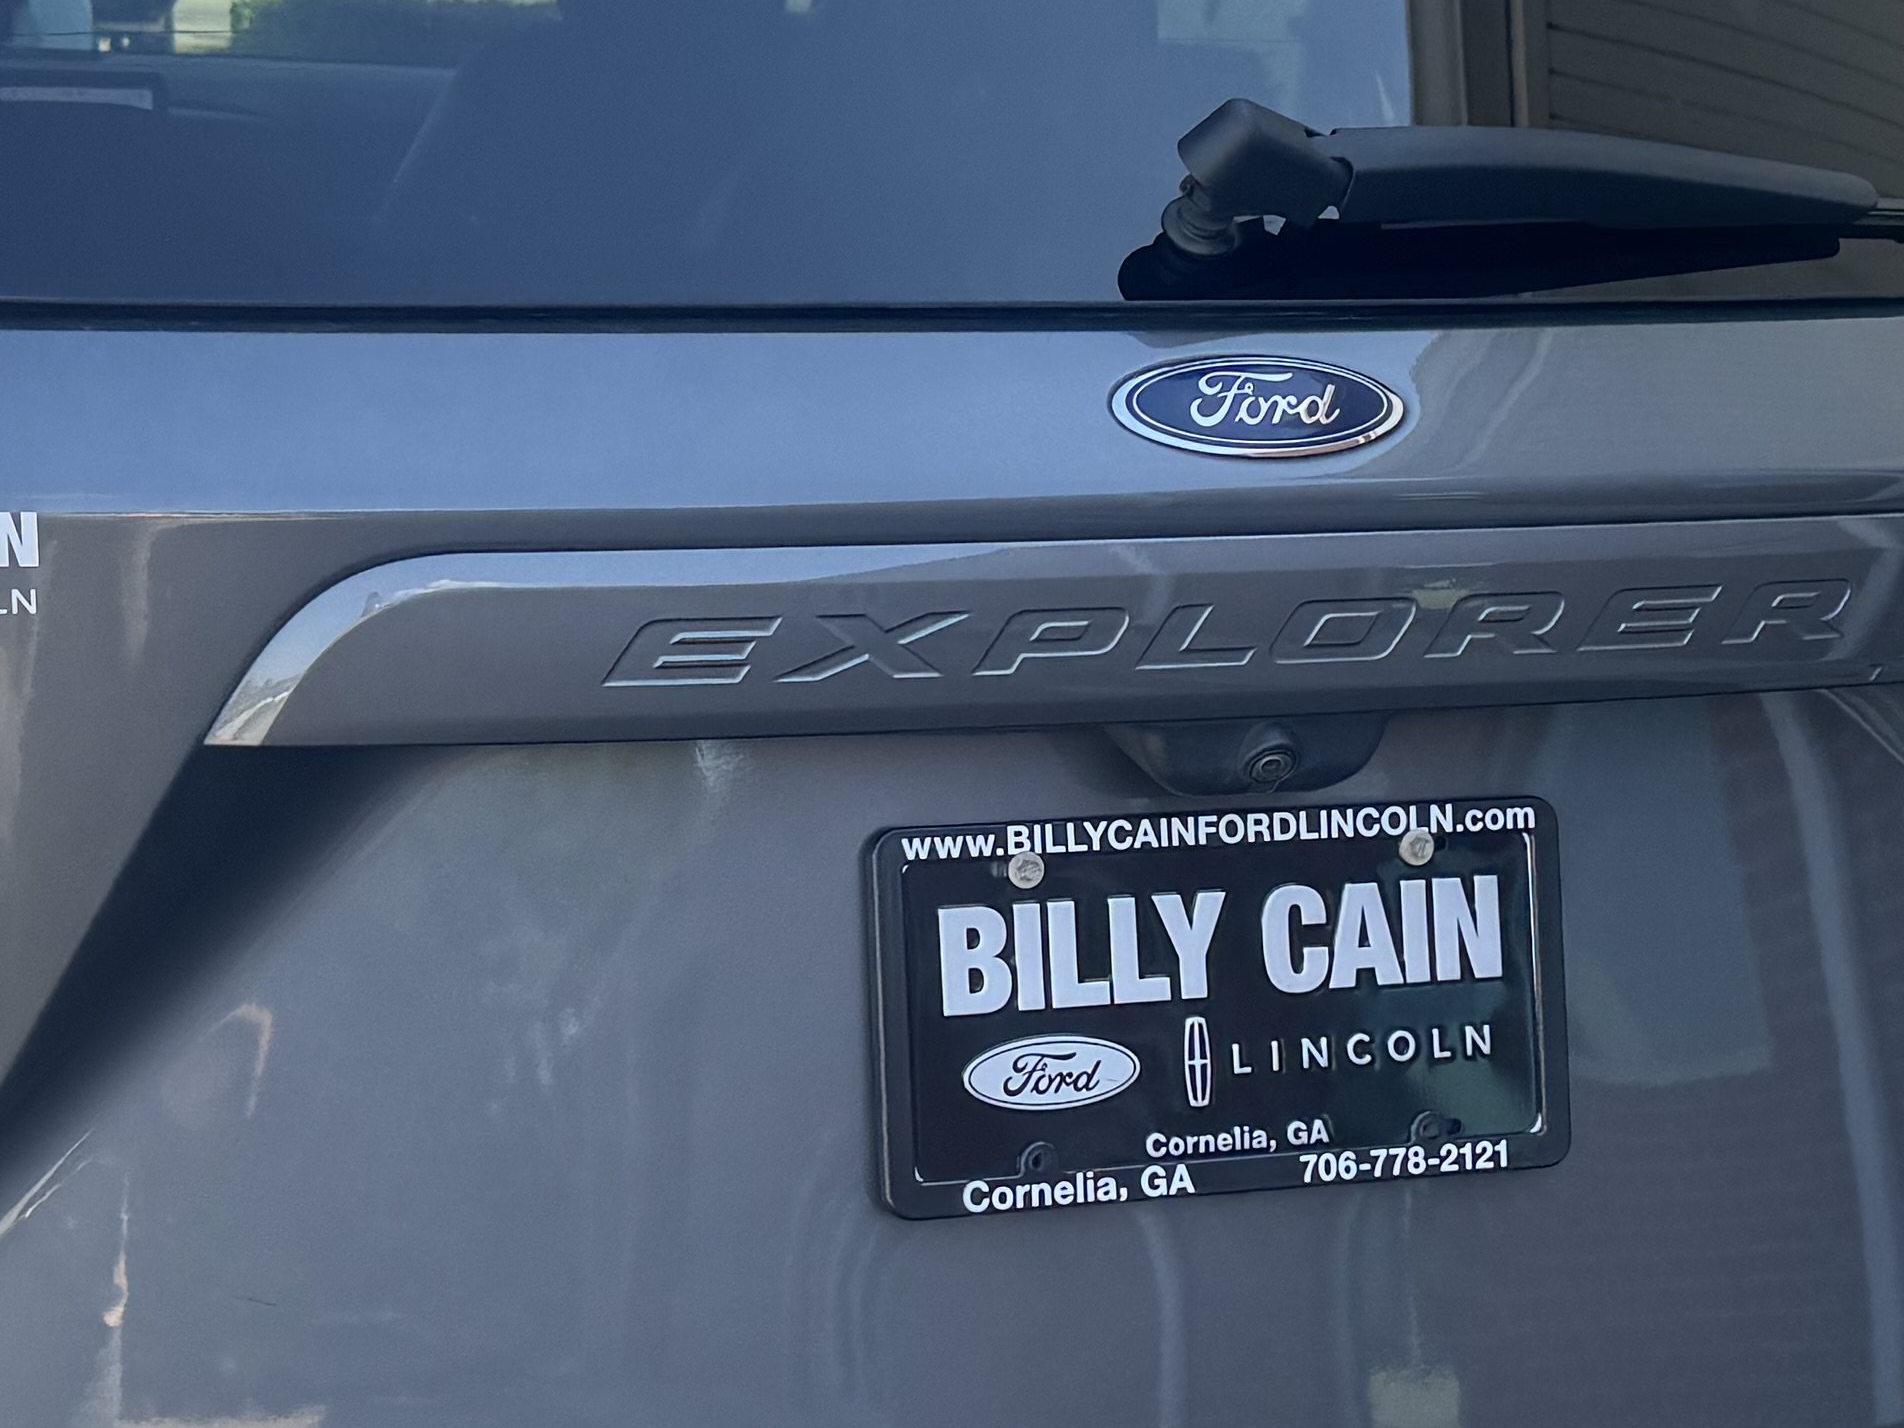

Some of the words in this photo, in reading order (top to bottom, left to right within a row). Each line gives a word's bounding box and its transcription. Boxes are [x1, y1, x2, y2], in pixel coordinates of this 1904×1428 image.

[1190, 371, 1340, 427] Ford
[601, 576, 1853, 687] EXPLORER
[901, 803, 1536, 861] www.BILLYCAINFORDLINCOLN.com
[938, 889, 1226, 1017] BILLY
[1261, 875, 1503, 994] CAIN
[1003, 1052, 1102, 1097] Ford
[1231, 1024, 1491, 1075] LINCOLN
[1146, 1125, 1277, 1158] Cornelia,
[1286, 1118, 1330, 1145] GA
[1299, 1139, 1508, 1184] 706-778-2121
[962, 1170, 1128, 1213] Cornelia,
[1140, 1163, 1196, 1197] GA
